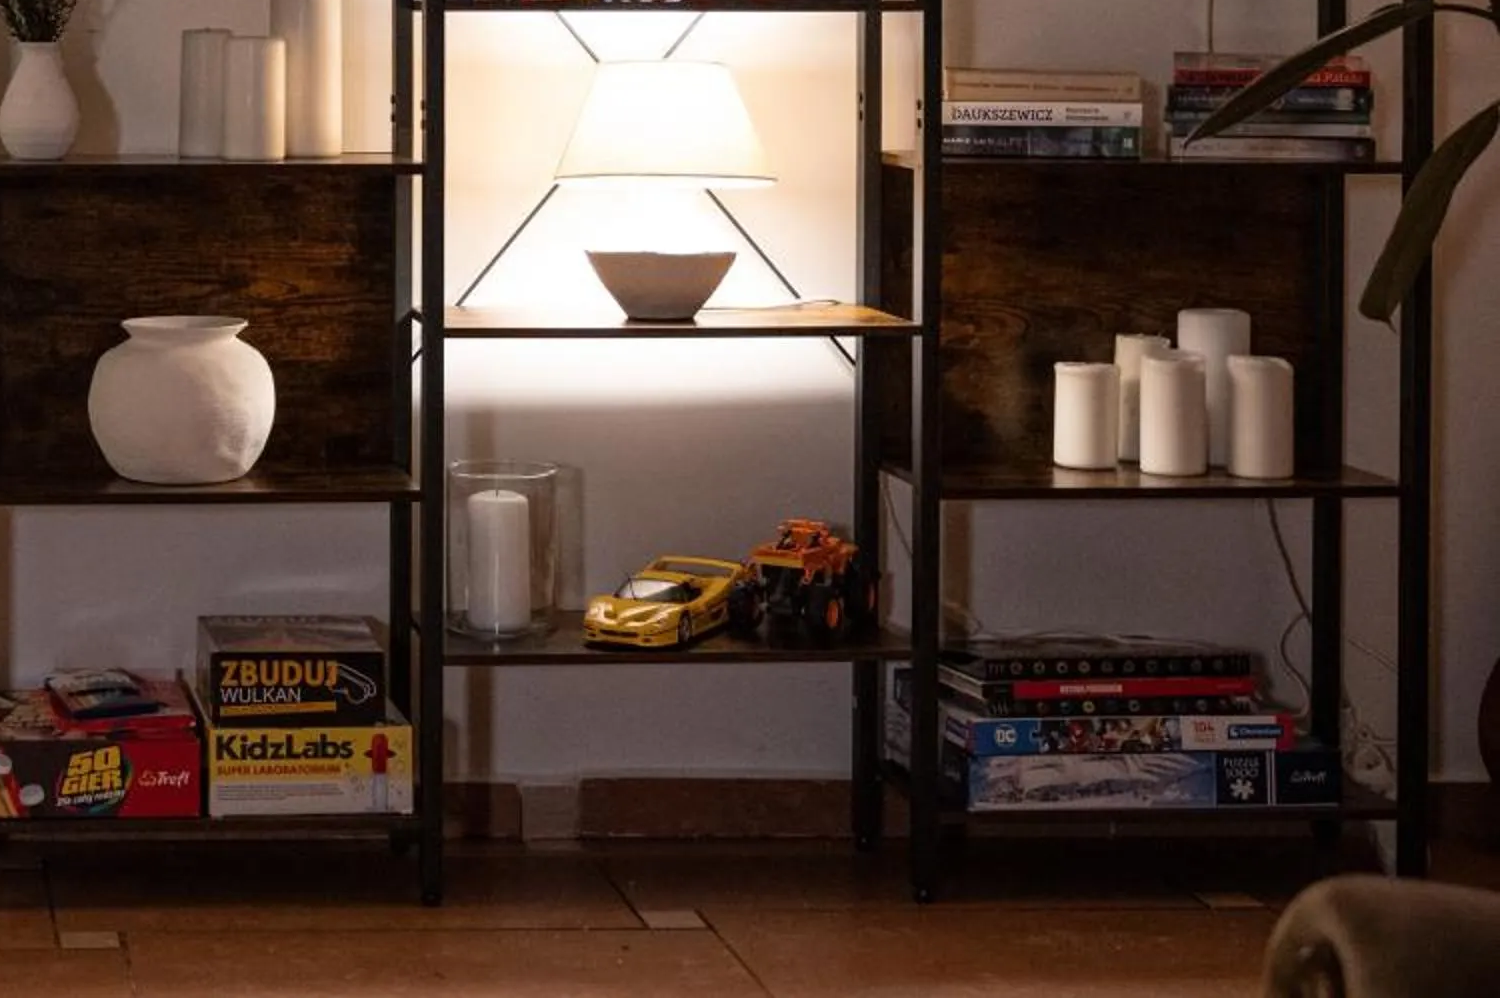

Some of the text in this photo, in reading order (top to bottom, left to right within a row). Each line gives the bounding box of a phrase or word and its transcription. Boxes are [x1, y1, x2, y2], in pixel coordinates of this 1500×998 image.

[951, 107, 1053, 122] DAUKSZEWICZ
[220, 659, 340, 688] ZBUDUJ
[220, 686, 301, 704] WULKAN
[994, 728, 1017, 743] DC
[216, 733, 354, 760] KidzLabs
[67, 745, 121, 778] 50
[1223, 756, 1261, 768] PUZZLE
[61, 769, 124, 796] GIER
[156, 769, 192, 789] Trefl
[1225, 768, 1260, 779] 1000
